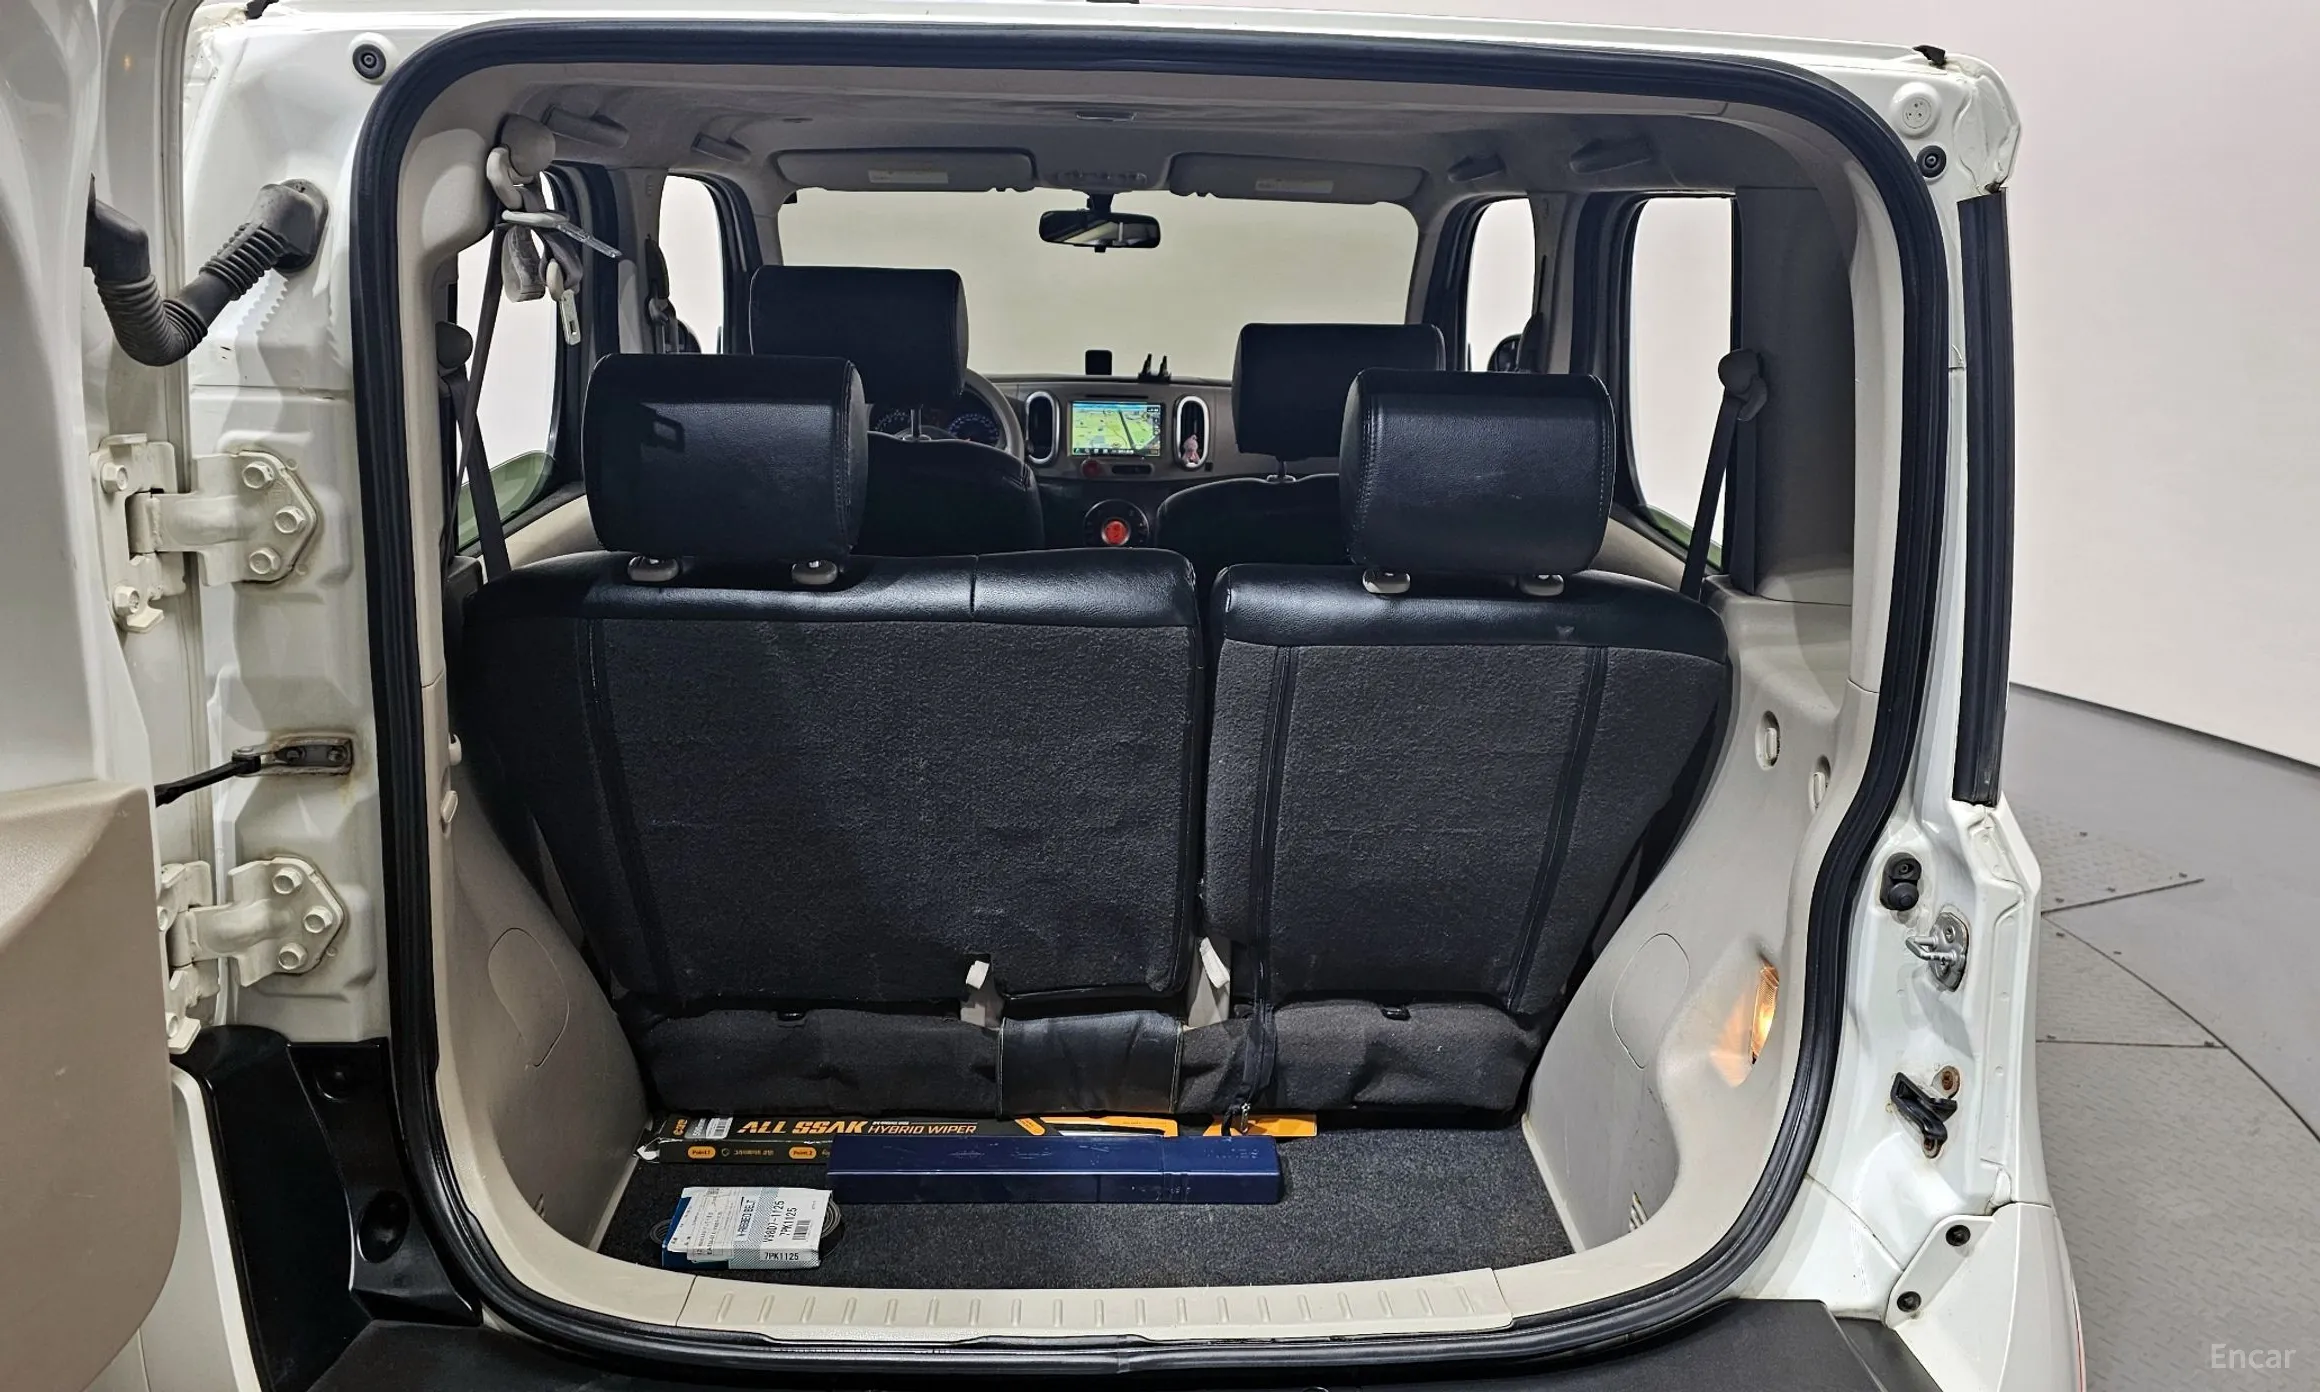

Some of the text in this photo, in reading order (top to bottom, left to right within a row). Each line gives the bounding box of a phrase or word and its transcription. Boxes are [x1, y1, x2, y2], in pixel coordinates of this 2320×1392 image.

[737, 1120, 869, 1134] ALL SSAK
[867, 1125, 977, 1134] HYBRID WIPER
[778, 1207, 798, 1237] 7PK1125
[764, 1252, 800, 1261] 7PK1125
